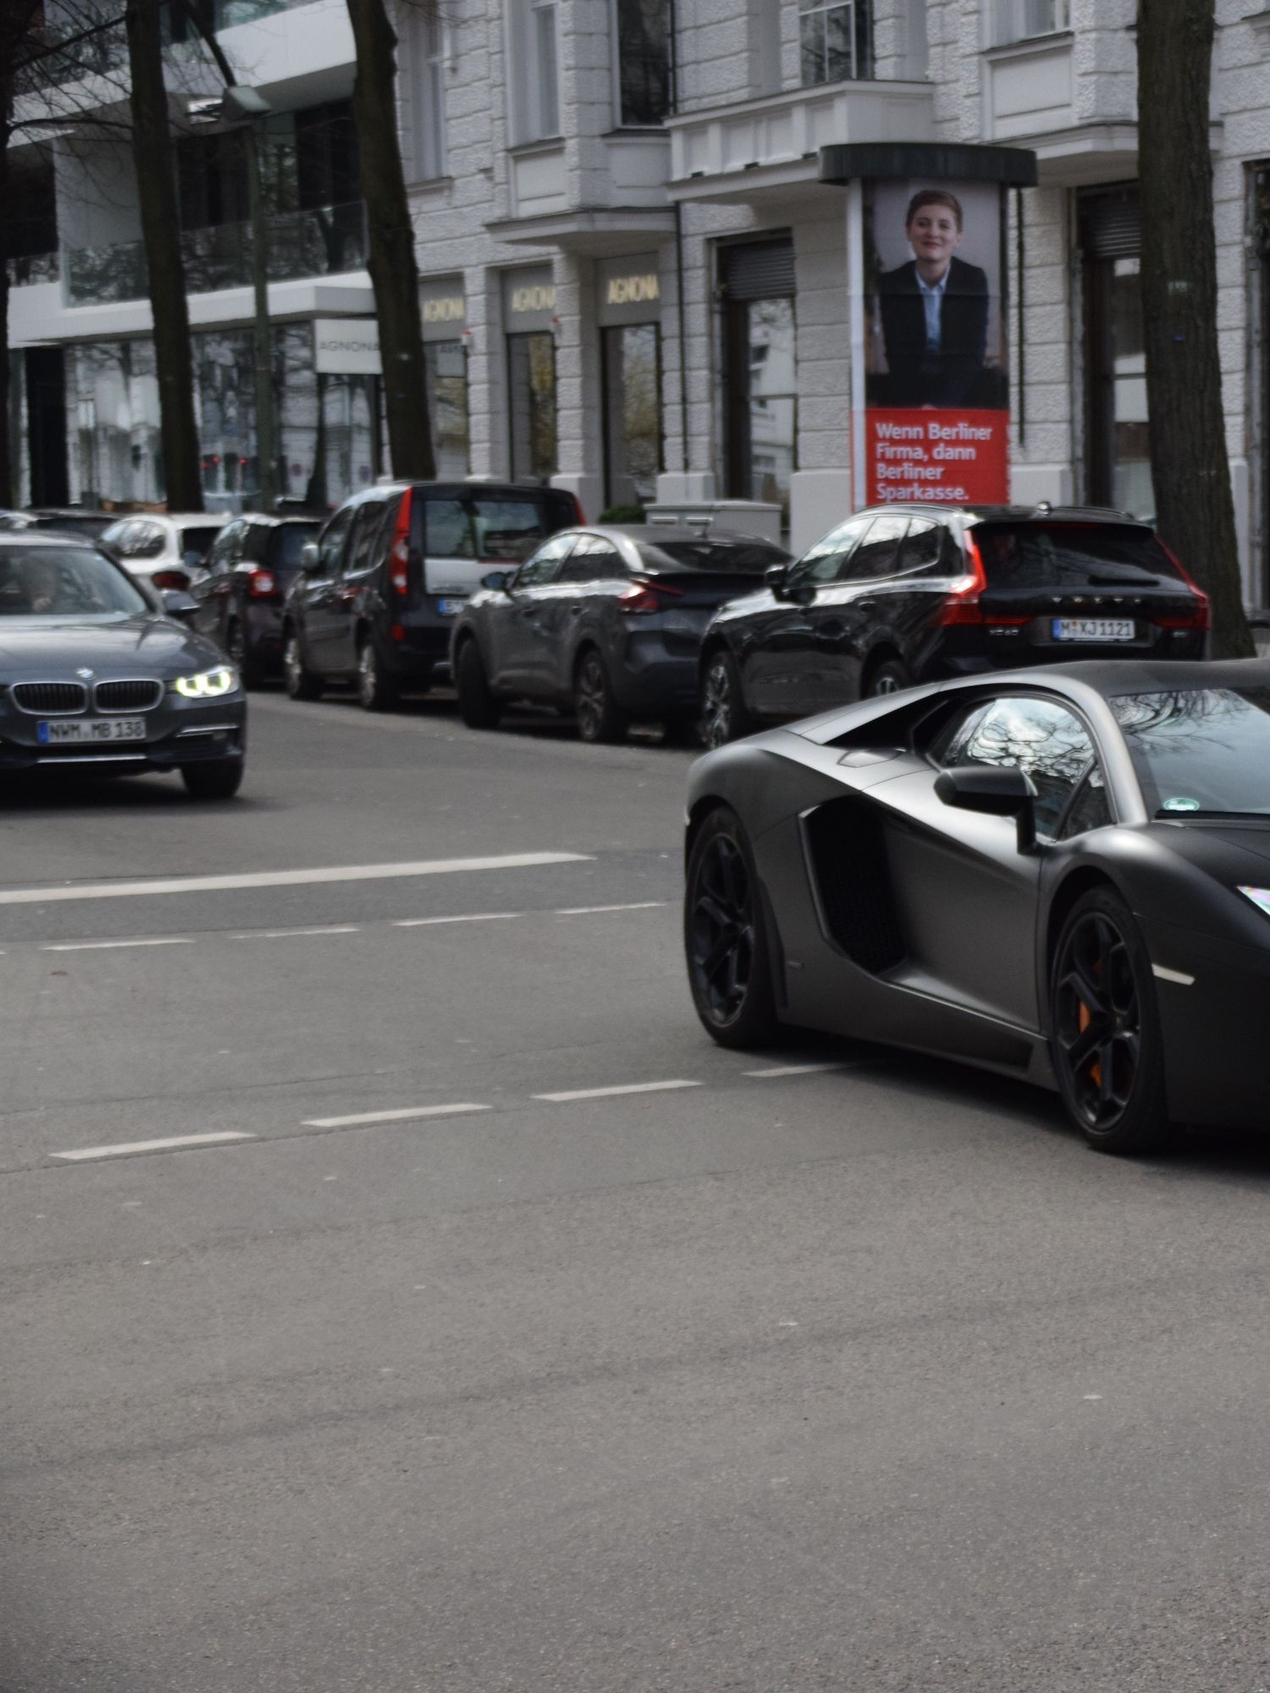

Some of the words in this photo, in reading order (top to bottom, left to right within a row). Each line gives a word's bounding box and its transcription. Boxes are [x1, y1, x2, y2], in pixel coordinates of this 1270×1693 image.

[875, 422, 924, 440] Wenn
[928, 422, 992, 440] Berliner
[876, 443, 929, 461] Firma,
[932, 443, 976, 460] dann
[876, 463, 944, 480] Berliner
[876, 483, 969, 502] Sparkasse.
[1061, 621, 1072, 637] M
[1080, 622, 1097, 637] XJ
[1100, 621, 1133, 637] 1121
[51, 723, 81, 739] NWM
[91, 722, 111, 738] MB
[116, 721, 143, 738] 138
